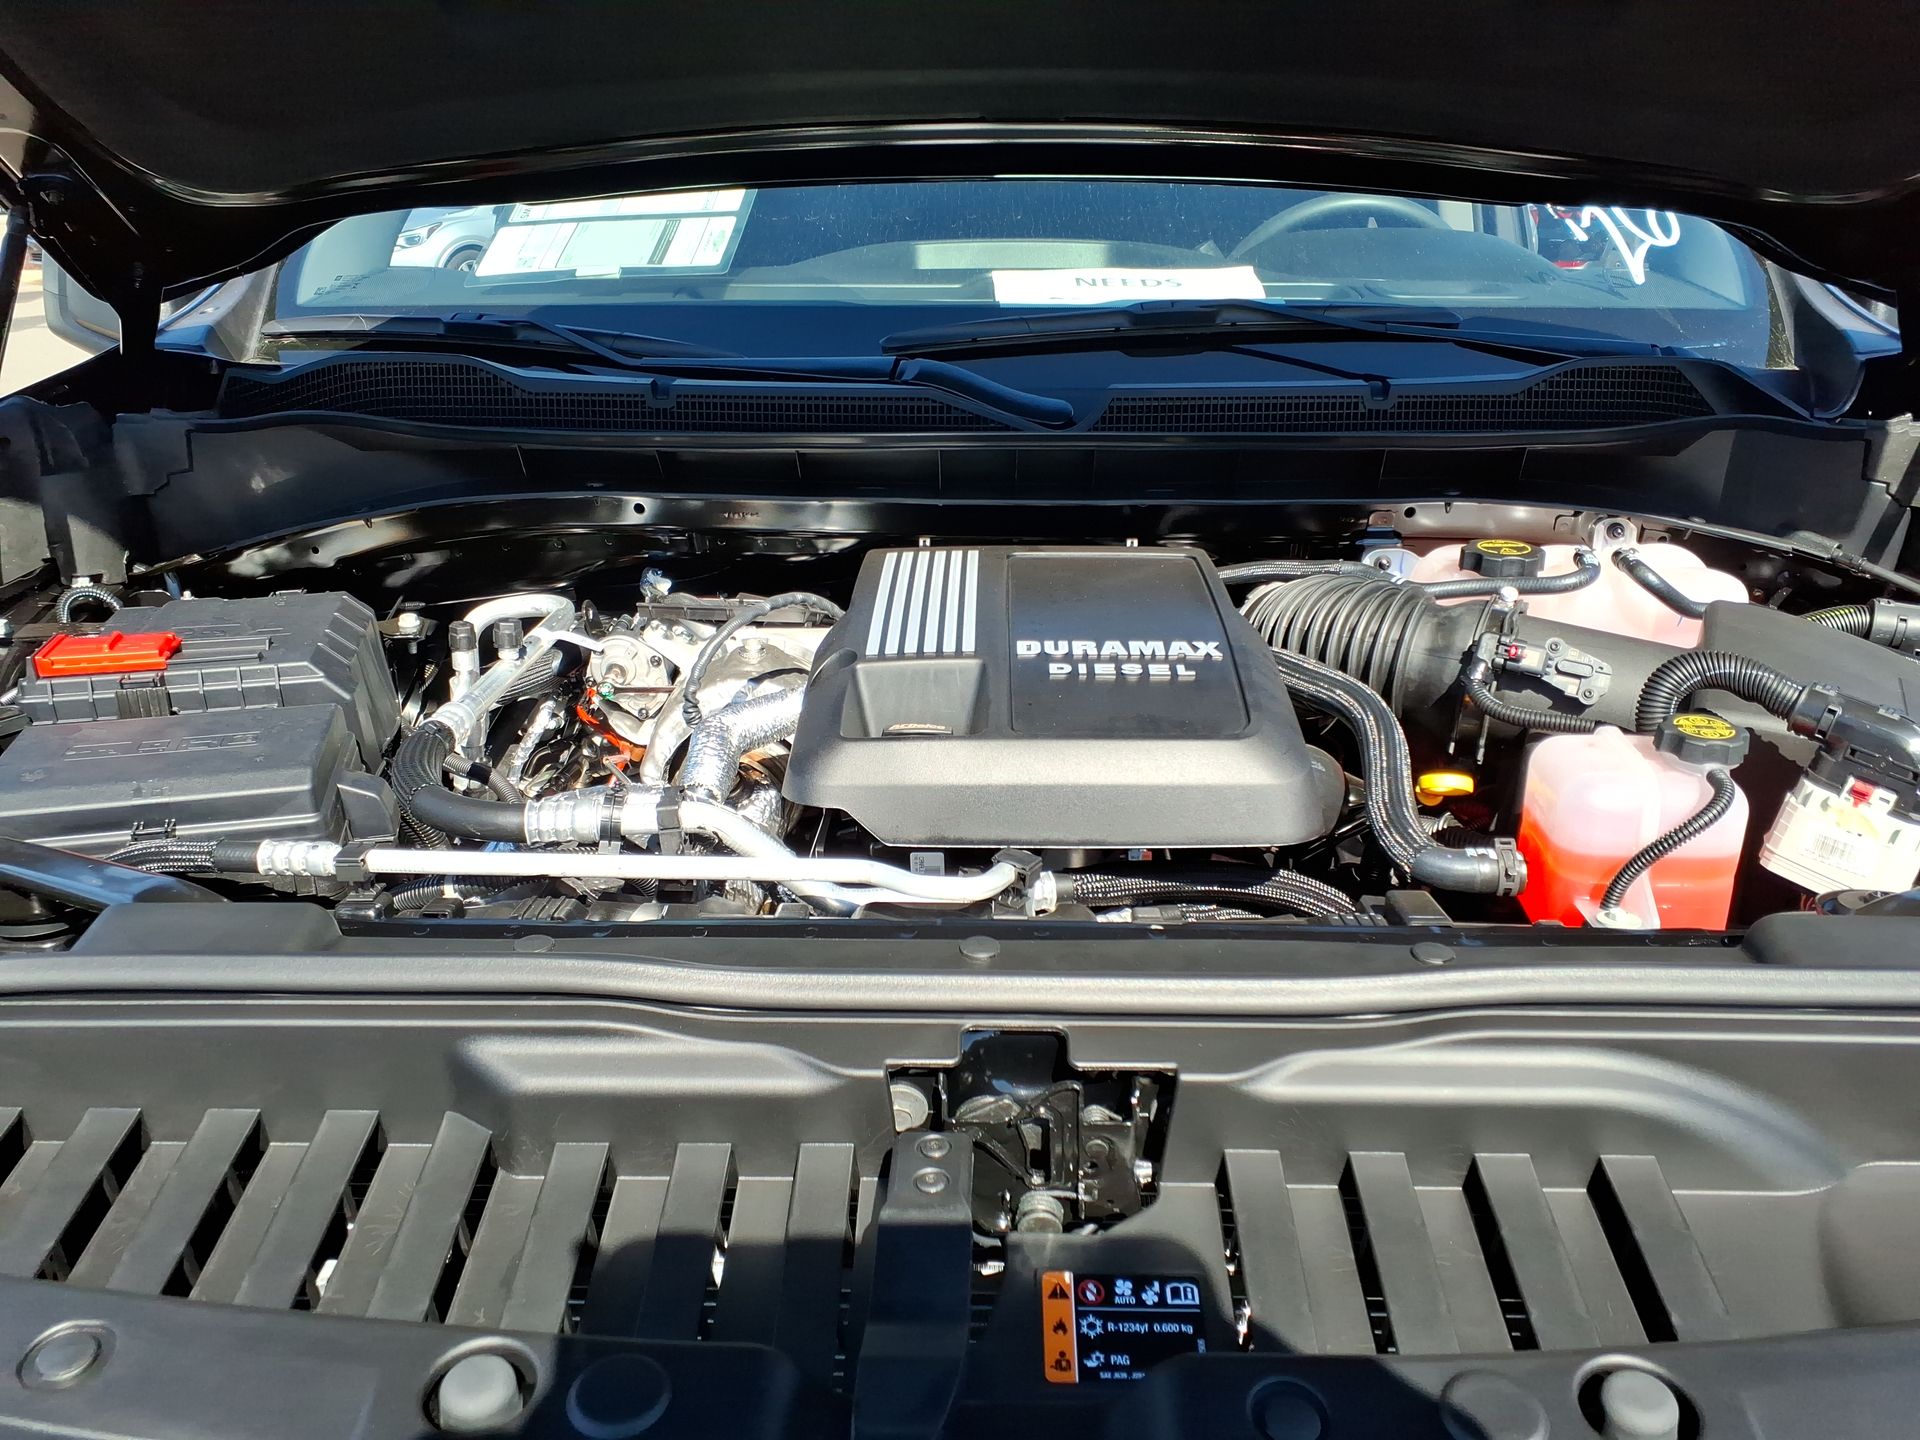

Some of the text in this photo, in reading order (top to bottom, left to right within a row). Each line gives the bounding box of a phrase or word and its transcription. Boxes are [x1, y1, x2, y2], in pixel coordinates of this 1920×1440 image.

[1075, 277, 1182, 287] NEEDS
[1016, 639, 1223, 658] DURAMAX
[1048, 663, 1197, 677] DIESEL
[1114, 1296, 1136, 1305] AUTO
[1153, 1322, 1180, 1333] 0.600
[1181, 1323, 1194, 1335] kg
[1110, 1354, 1131, 1366] PAG
